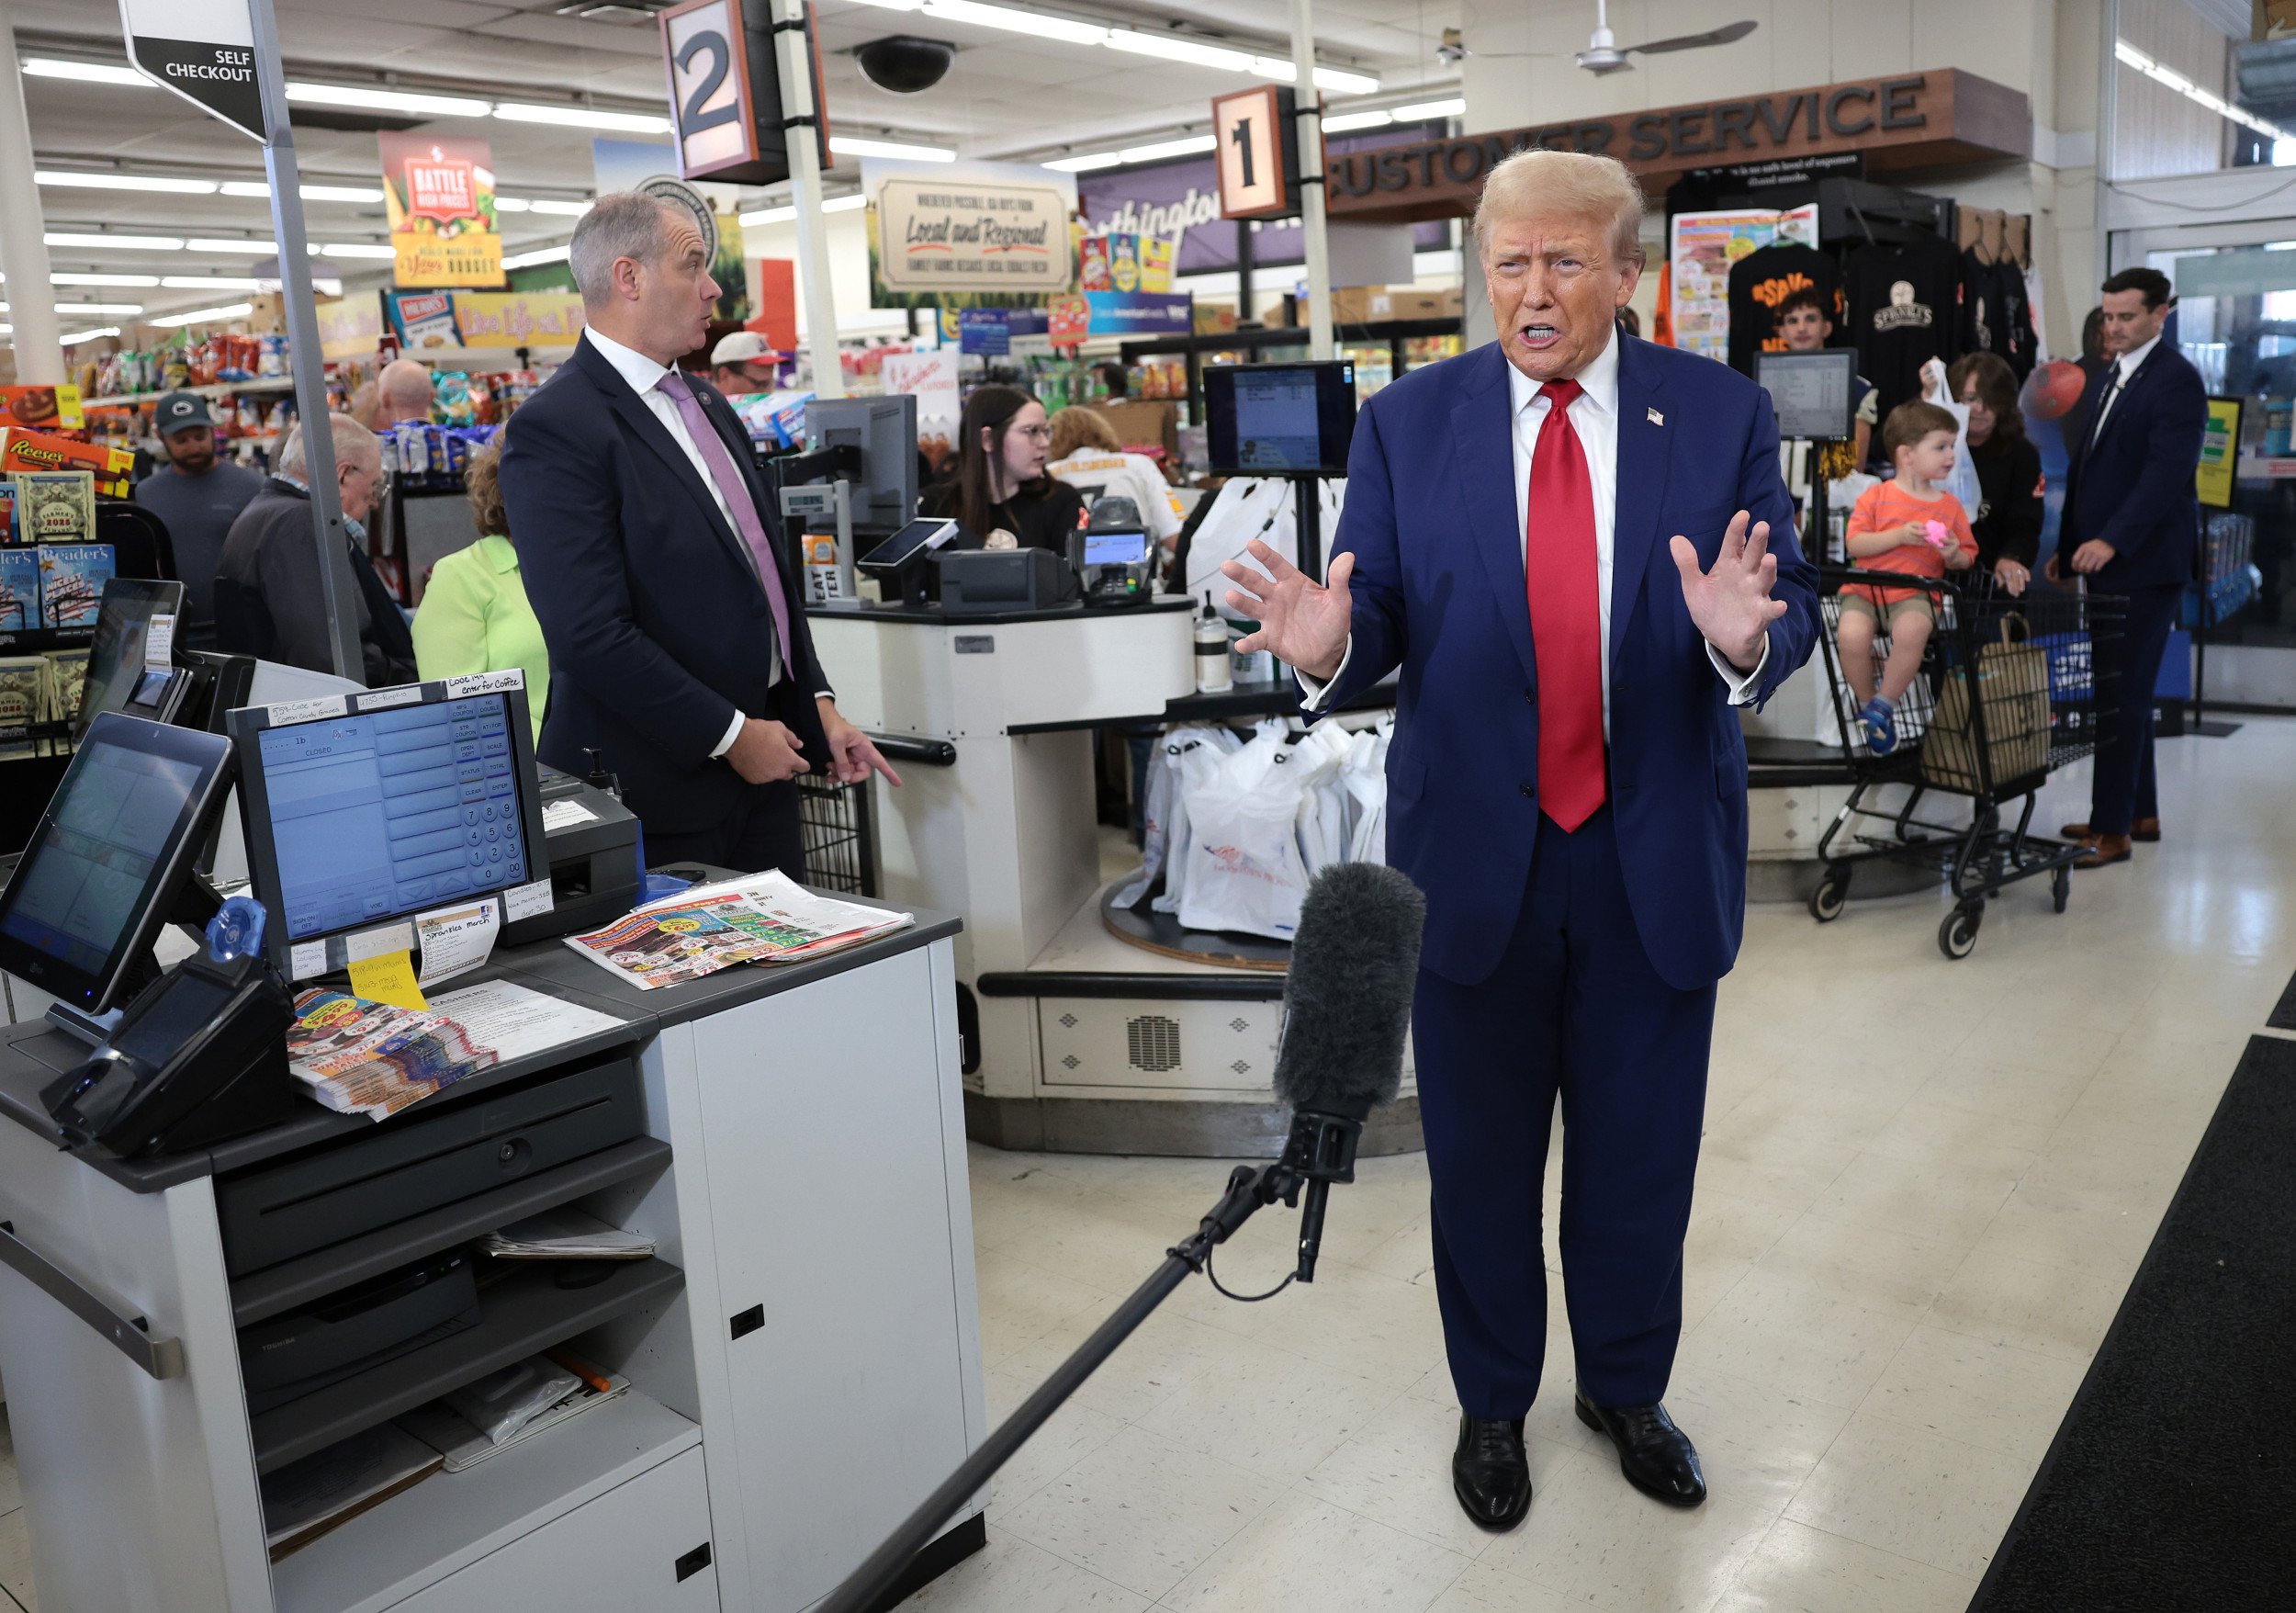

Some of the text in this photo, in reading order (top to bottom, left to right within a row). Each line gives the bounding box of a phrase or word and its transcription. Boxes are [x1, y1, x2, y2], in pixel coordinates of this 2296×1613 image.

[215, 50, 250, 65] SELF
[165, 62, 253, 82] CHECKOUT
[674, 30, 741, 142] 2
[1628, 76, 1926, 160] SERVICE
[1232, 118, 1256, 188] 1
[413, 168, 468, 193] BATTLE
[906, 214, 1048, 251] Local and Regional
[461, 306, 499, 336] Live
[10, 440, 64, 463] Reese's
[42, 547, 108, 560] Reader's
[44, 580, 85, 603] PLACES
[449, 676, 469, 687] Code
[462, 676, 521, 694] enter for Coffee
[277, 714, 298, 724] Cotton
[299, 711, 317, 719] Candy
[452, 709, 474, 717] COUPON
[305, 746, 332, 757] CLOSED
[487, 742, 502, 750] SCALE
[461, 768, 480, 776] STATUS
[465, 788, 481, 796] CLEAR
[492, 783, 508, 791] ENTER
[487, 807, 492, 816] 8
[504, 804, 510, 812] 9
[468, 811, 474, 819] 7
[490, 827, 495, 836] 5
[507, 823, 512, 832] 6
[471, 831, 477, 840] 4
[492, 848, 498, 856] 2
[485, 869, 491, 878] 0
[509, 863, 520, 873] 00
[614, 917, 638, 931] Daily
[639, 907, 678, 918] Specials
[692, 900, 716, 908] Page
[425, 924, 462, 942] Sprankles
[431, 988, 490, 1008] CASHIERS
[262, 1337, 296, 1351] TOSHIBA
